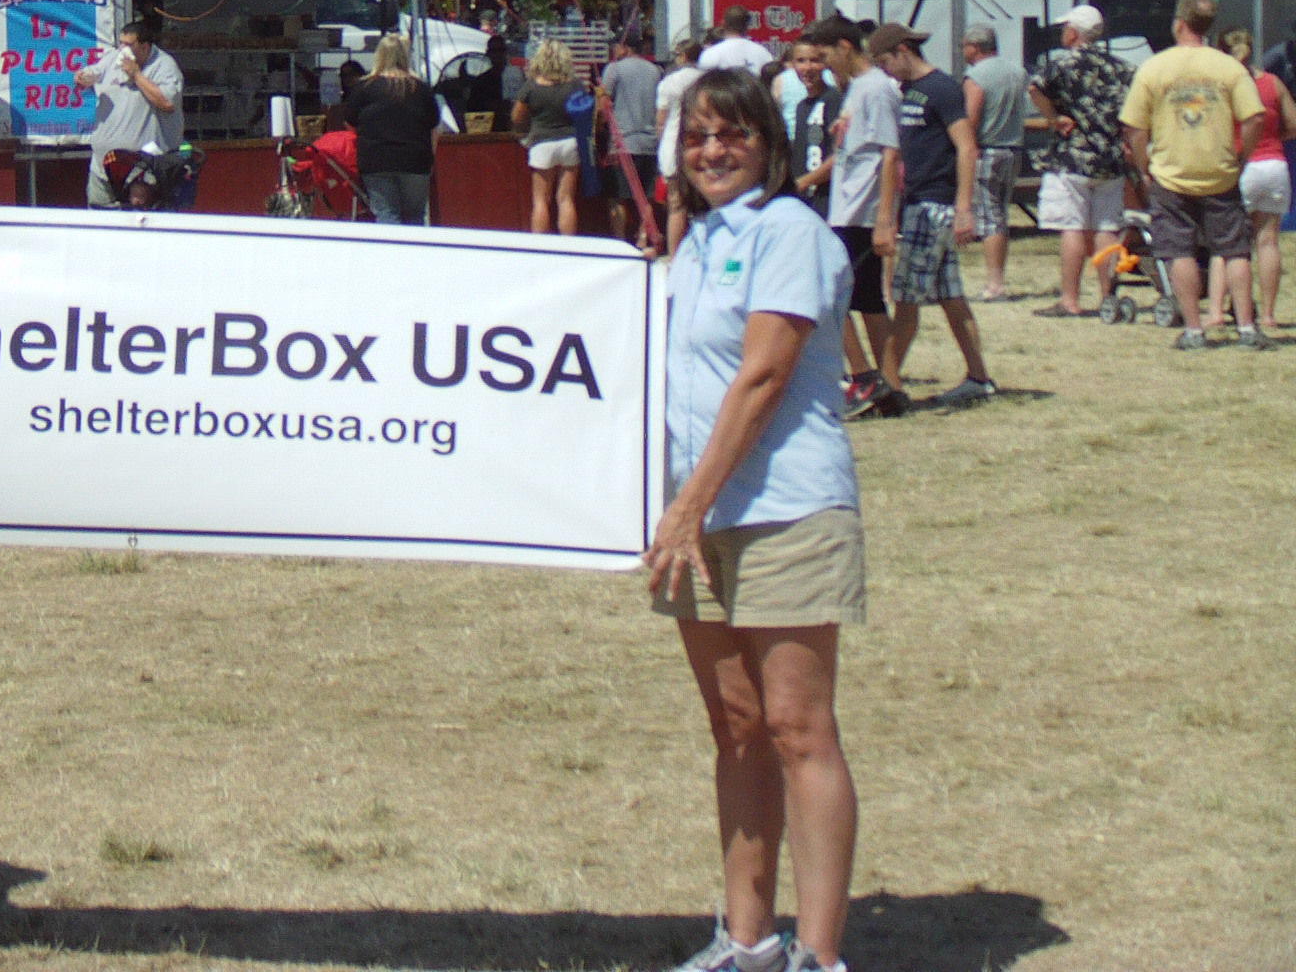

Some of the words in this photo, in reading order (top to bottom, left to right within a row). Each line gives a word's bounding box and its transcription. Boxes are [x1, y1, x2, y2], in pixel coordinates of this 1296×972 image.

[31, 14, 71, 39] 1ST
[1, 48, 104, 74] PLACE
[25, 85, 84, 110] RIBS
[411, 319, 603, 400] USA
[29, 397, 458, 457] shelterboxusa.org
